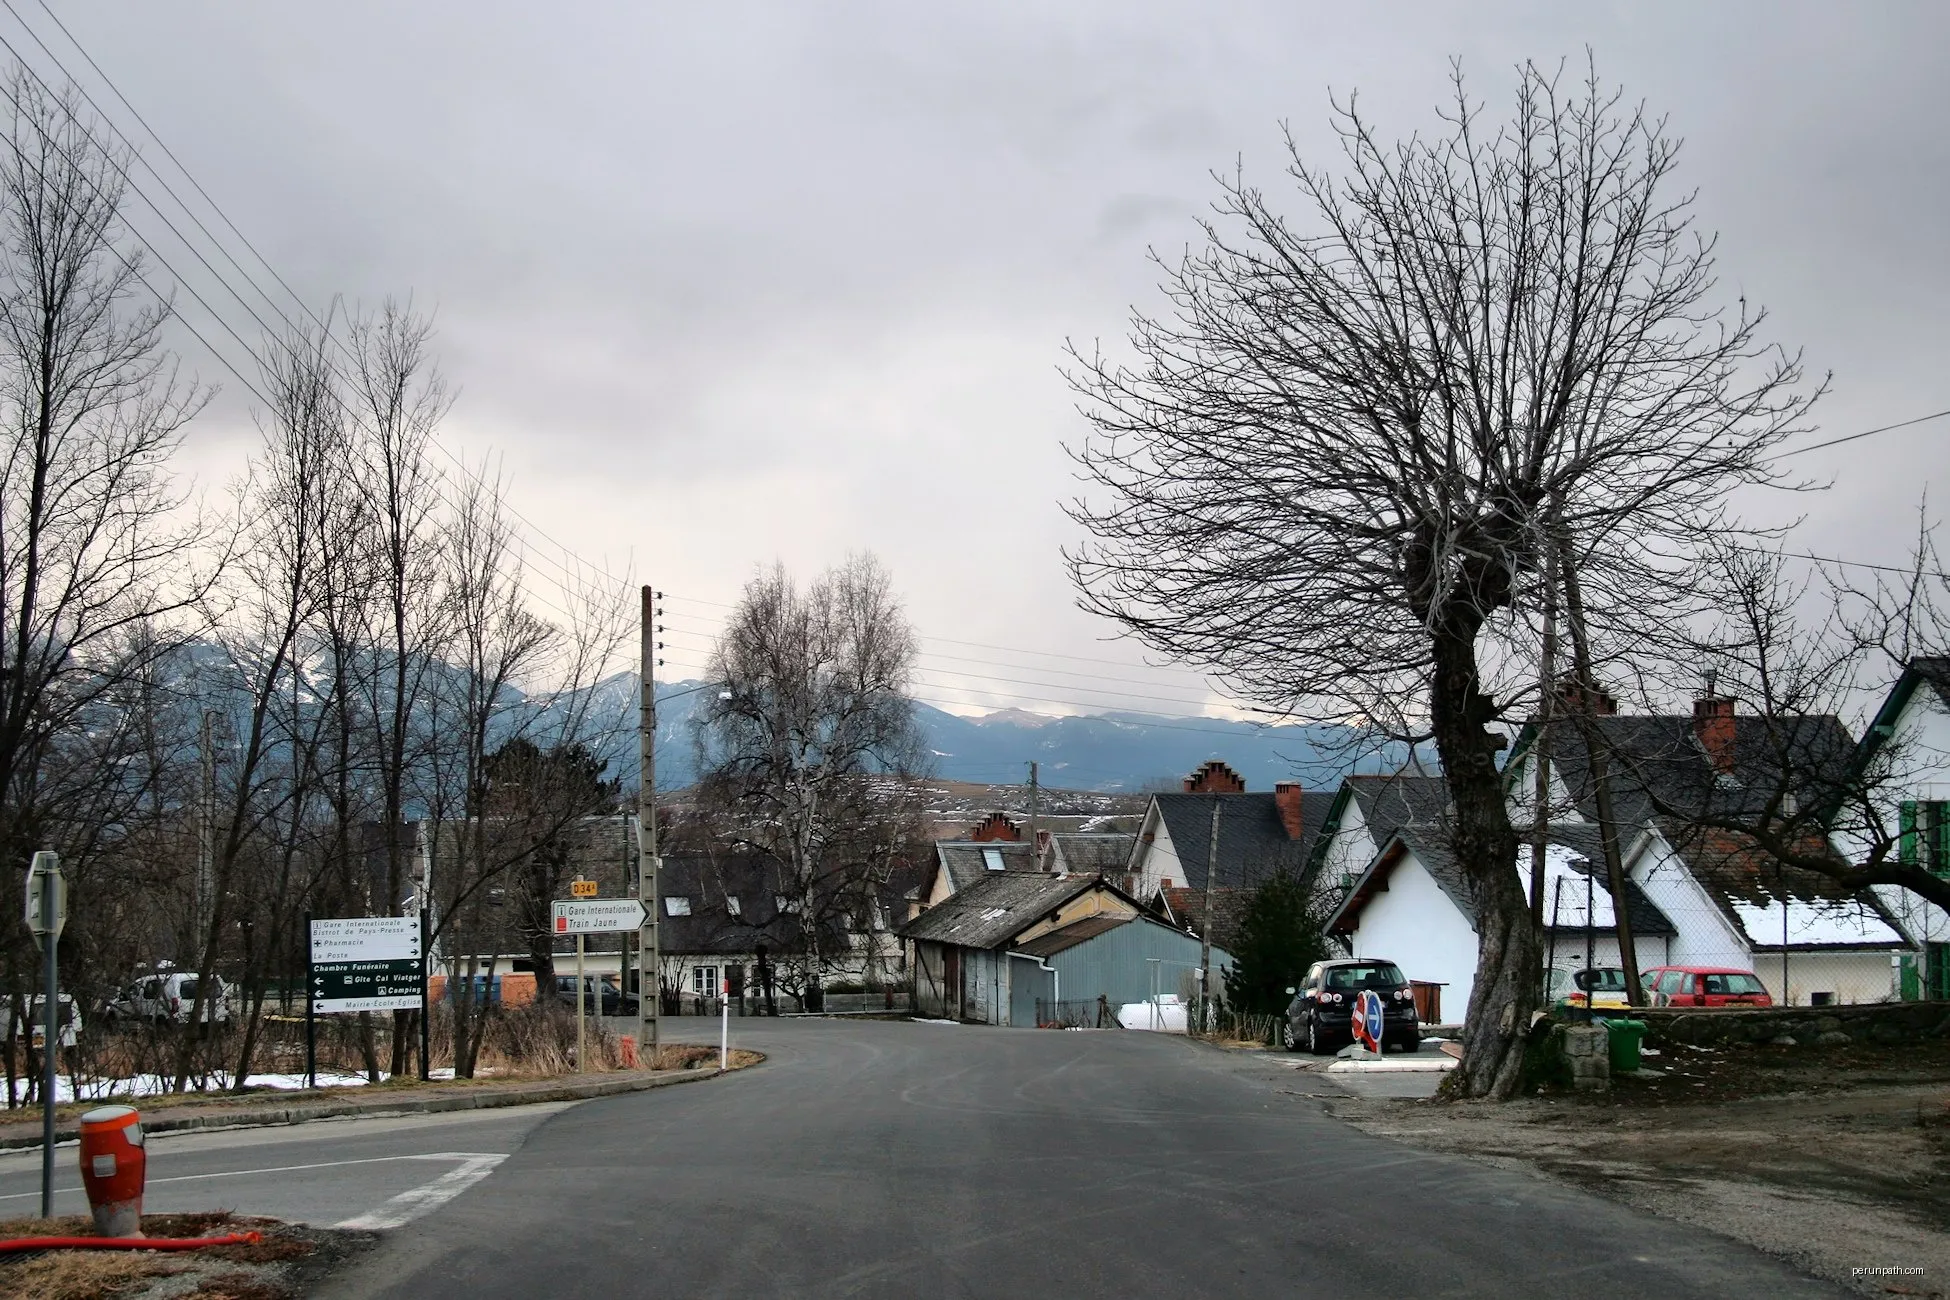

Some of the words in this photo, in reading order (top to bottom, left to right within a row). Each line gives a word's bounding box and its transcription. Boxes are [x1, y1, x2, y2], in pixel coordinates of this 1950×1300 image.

[568, 906, 586, 916] Gare
[587, 904, 637, 915] Internationale
[346, 919, 401, 928] Internationale
[569, 919, 590, 928] Train
[593, 918, 618, 928] Jaune
[323, 939, 364, 947] Pharmacie
[352, 962, 390, 970] Funéraire
[387, 986, 421, 995] Camping
